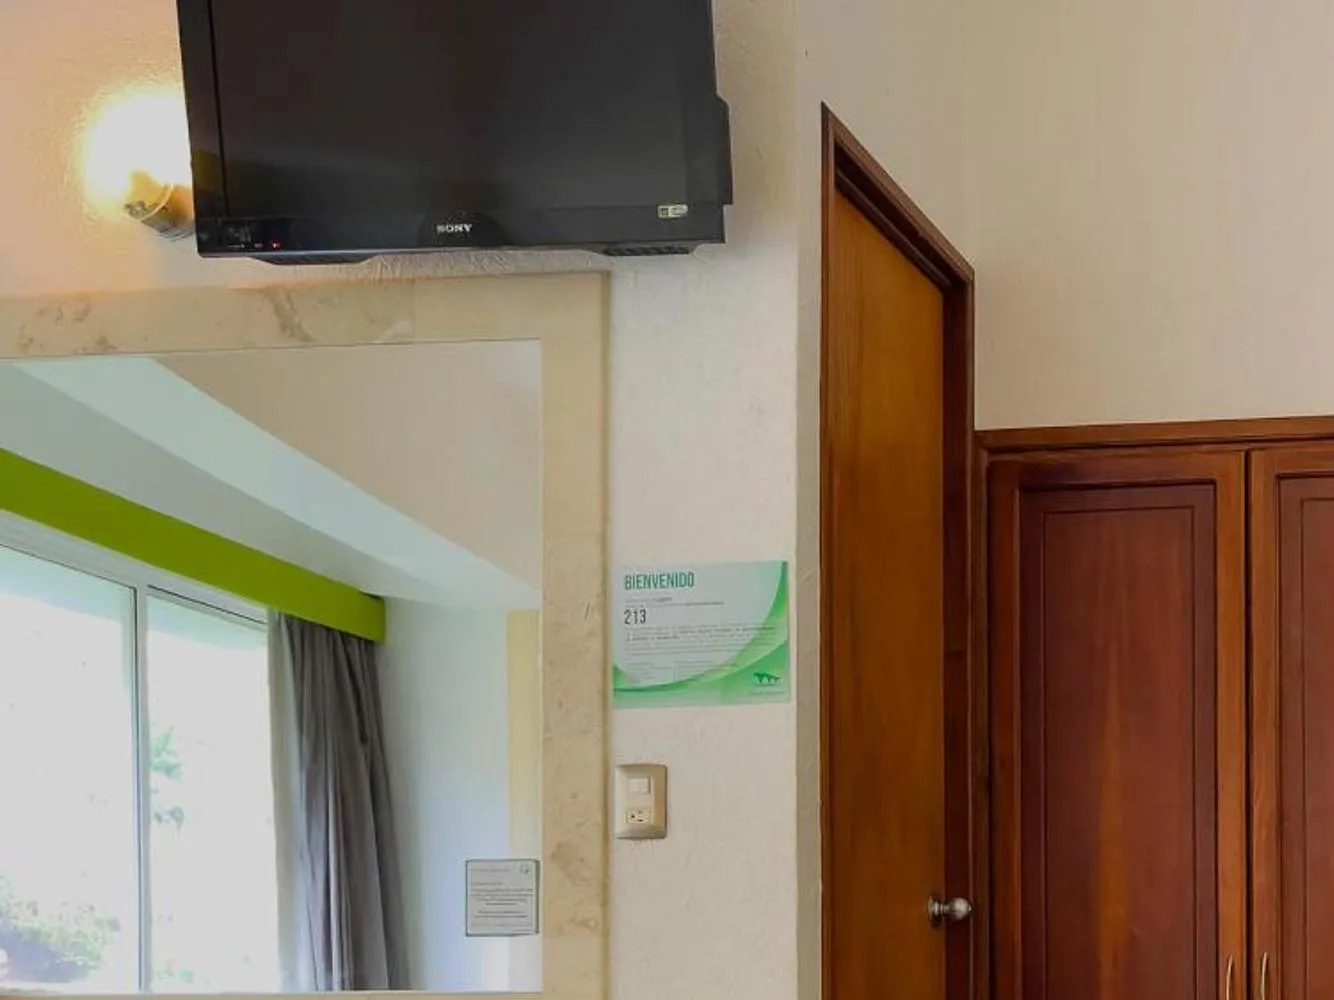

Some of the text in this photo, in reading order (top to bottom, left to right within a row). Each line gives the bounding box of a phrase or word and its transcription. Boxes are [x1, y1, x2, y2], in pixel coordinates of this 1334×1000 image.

[436, 223, 472, 233] SONY
[624, 571, 695, 590] BIENVENIDO
[623, 608, 647, 625] 213
